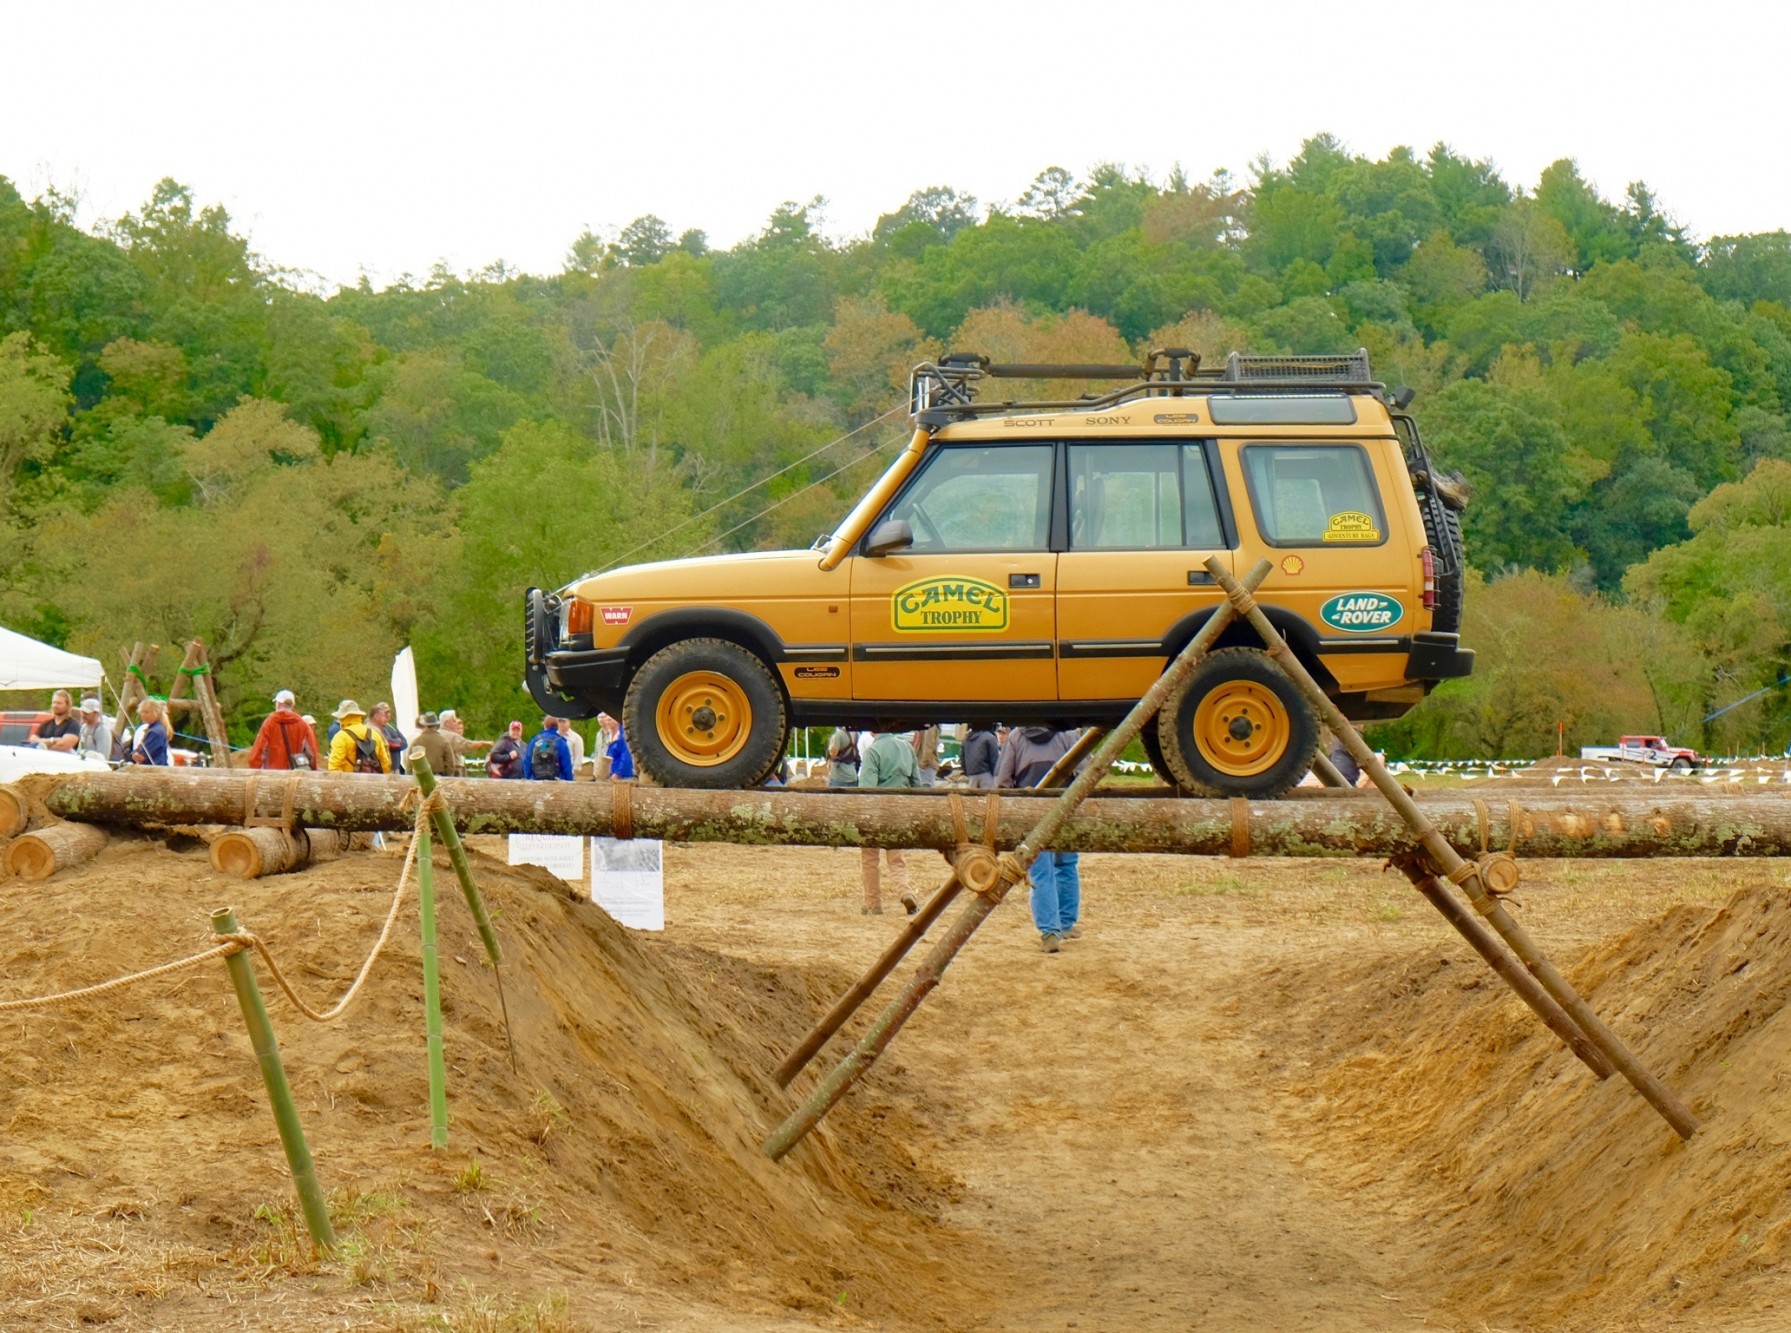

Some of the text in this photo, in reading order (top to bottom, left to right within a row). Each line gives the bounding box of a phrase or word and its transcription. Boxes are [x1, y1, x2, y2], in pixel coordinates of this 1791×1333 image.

[1003, 419, 1055, 427] SCOTT
[1085, 416, 1132, 425] SONY
[1332, 515, 1369, 526] CAMEL
[900, 584, 1000, 614] CAMEL
[604, 612, 628, 620] WARN
[921, 611, 982, 624] TROPHY
[1341, 611, 1391, 624] ROVER
